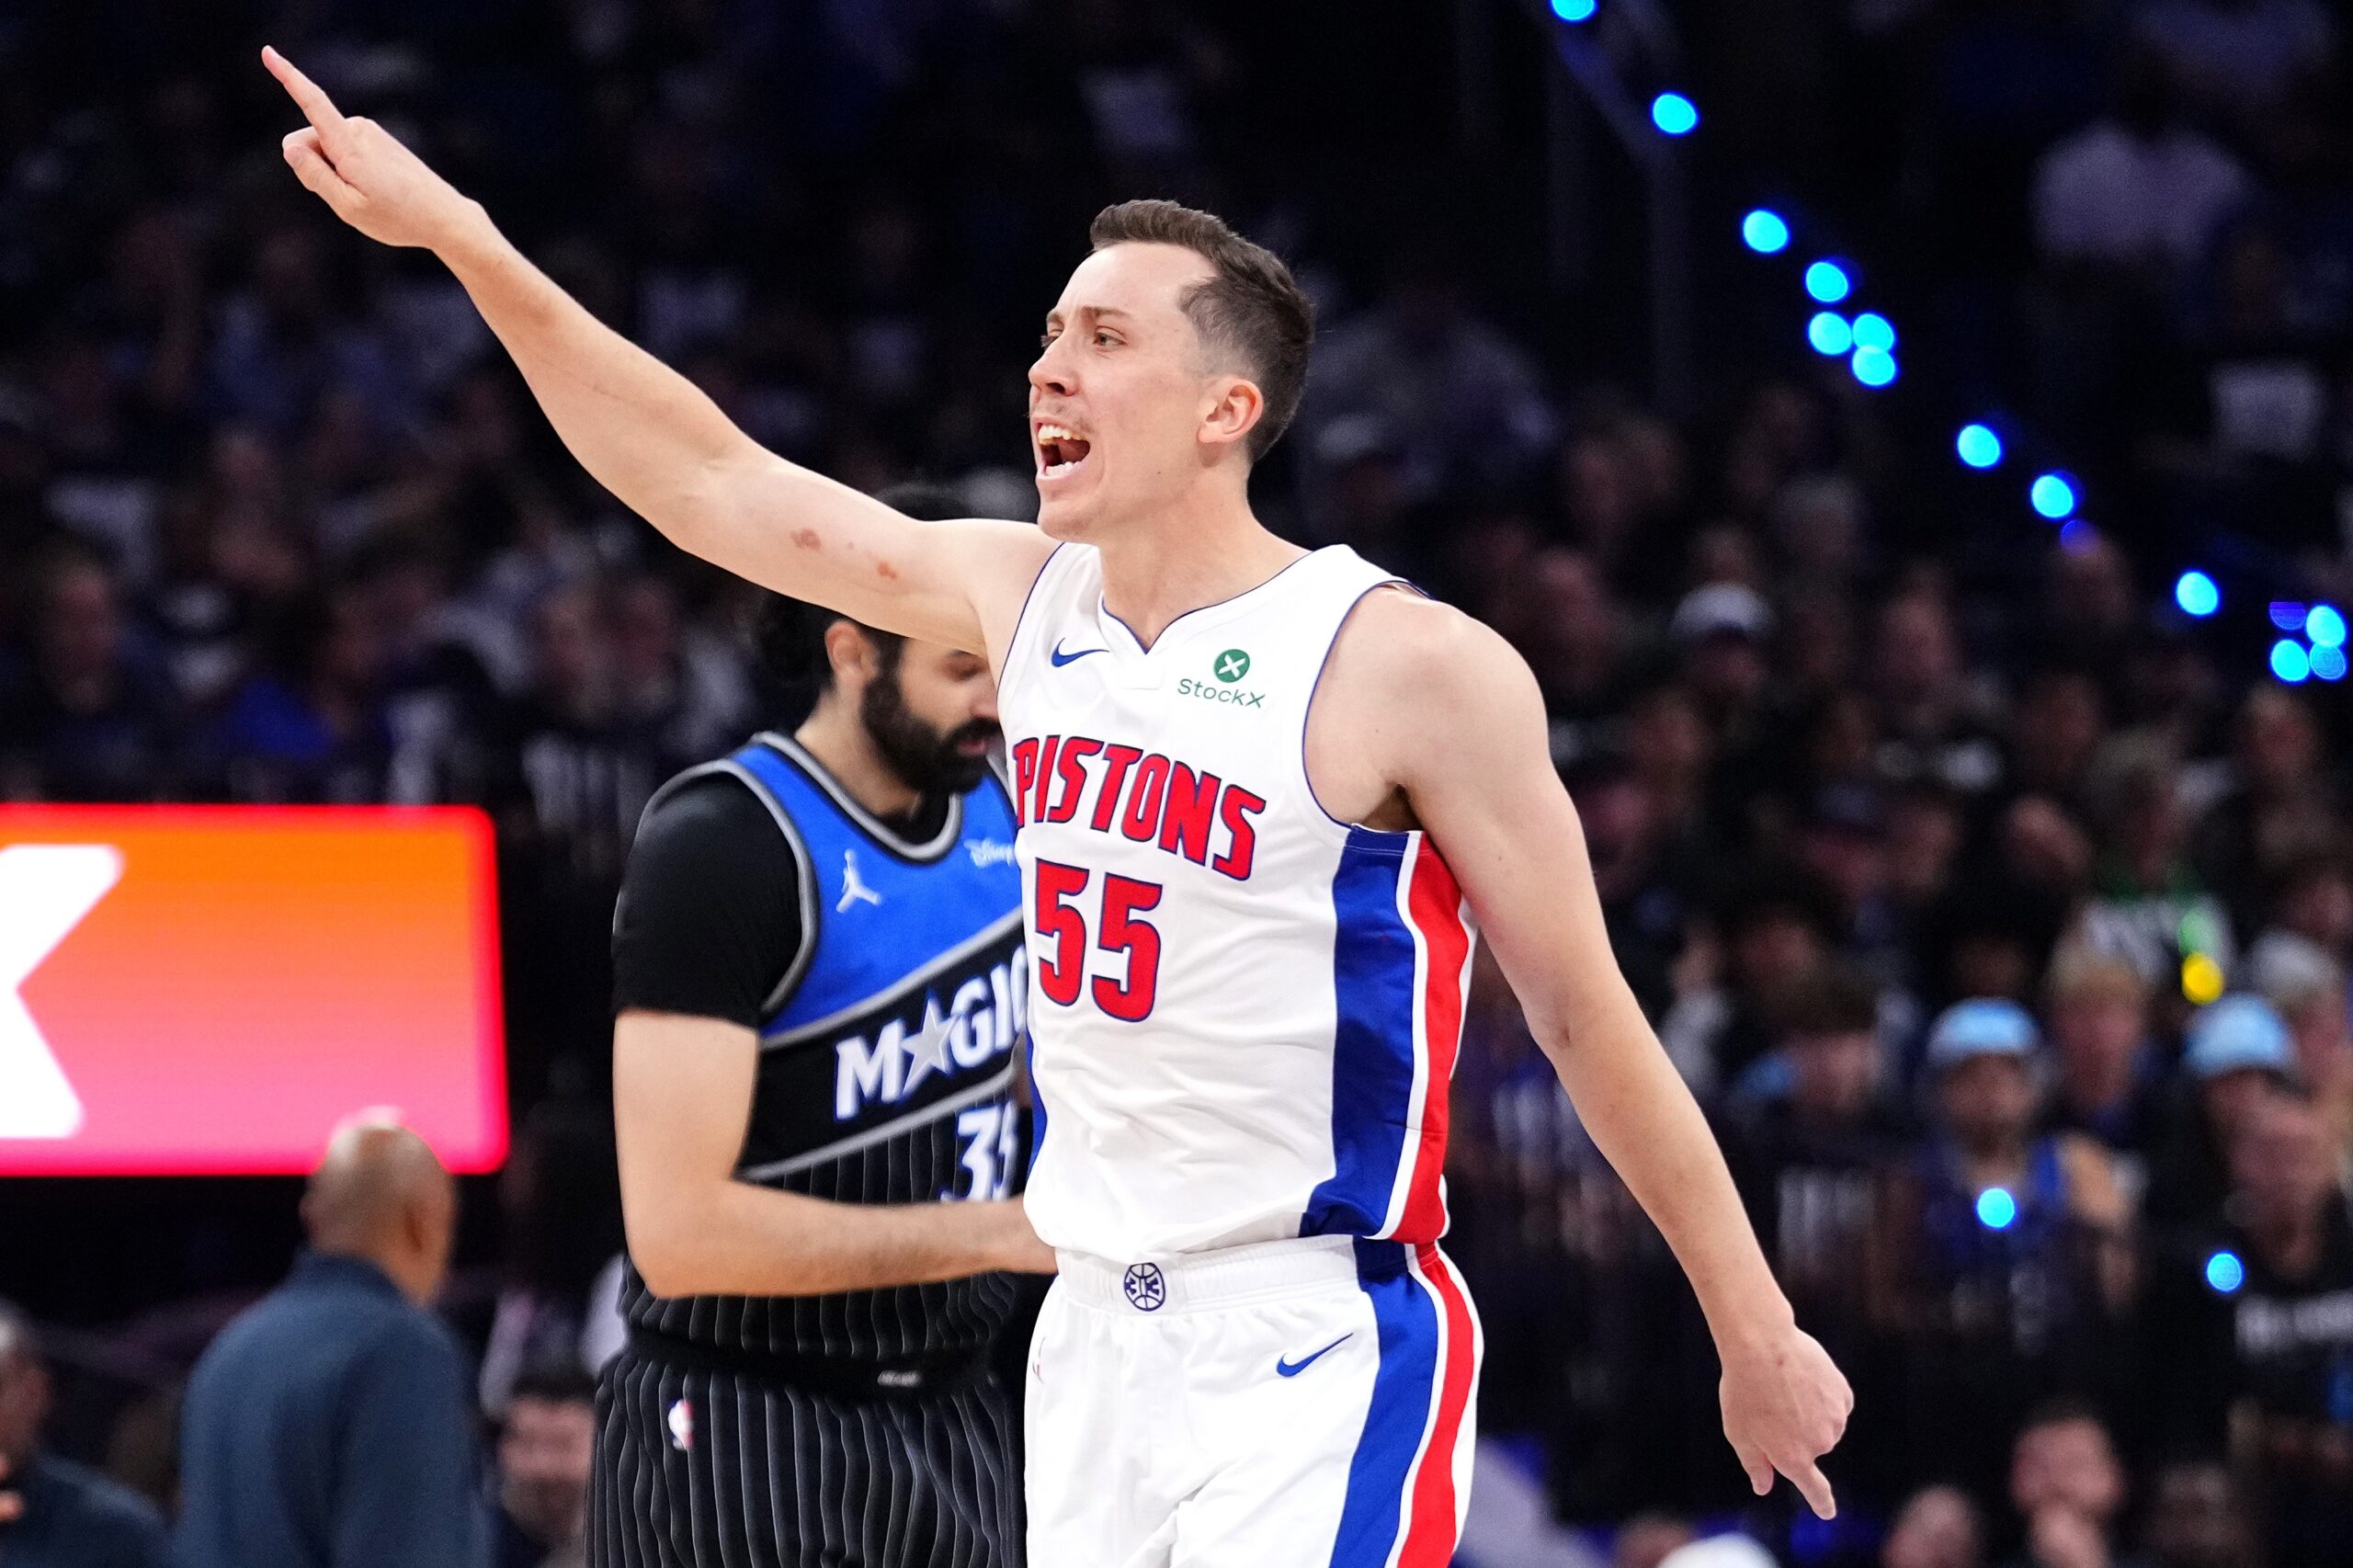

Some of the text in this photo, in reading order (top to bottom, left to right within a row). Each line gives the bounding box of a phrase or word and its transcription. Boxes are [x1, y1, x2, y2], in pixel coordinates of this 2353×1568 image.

[1177, 678, 1266, 709] StockX
[1013, 734, 1267, 881] PISTONS
[1035, 858, 1163, 1022] 55
